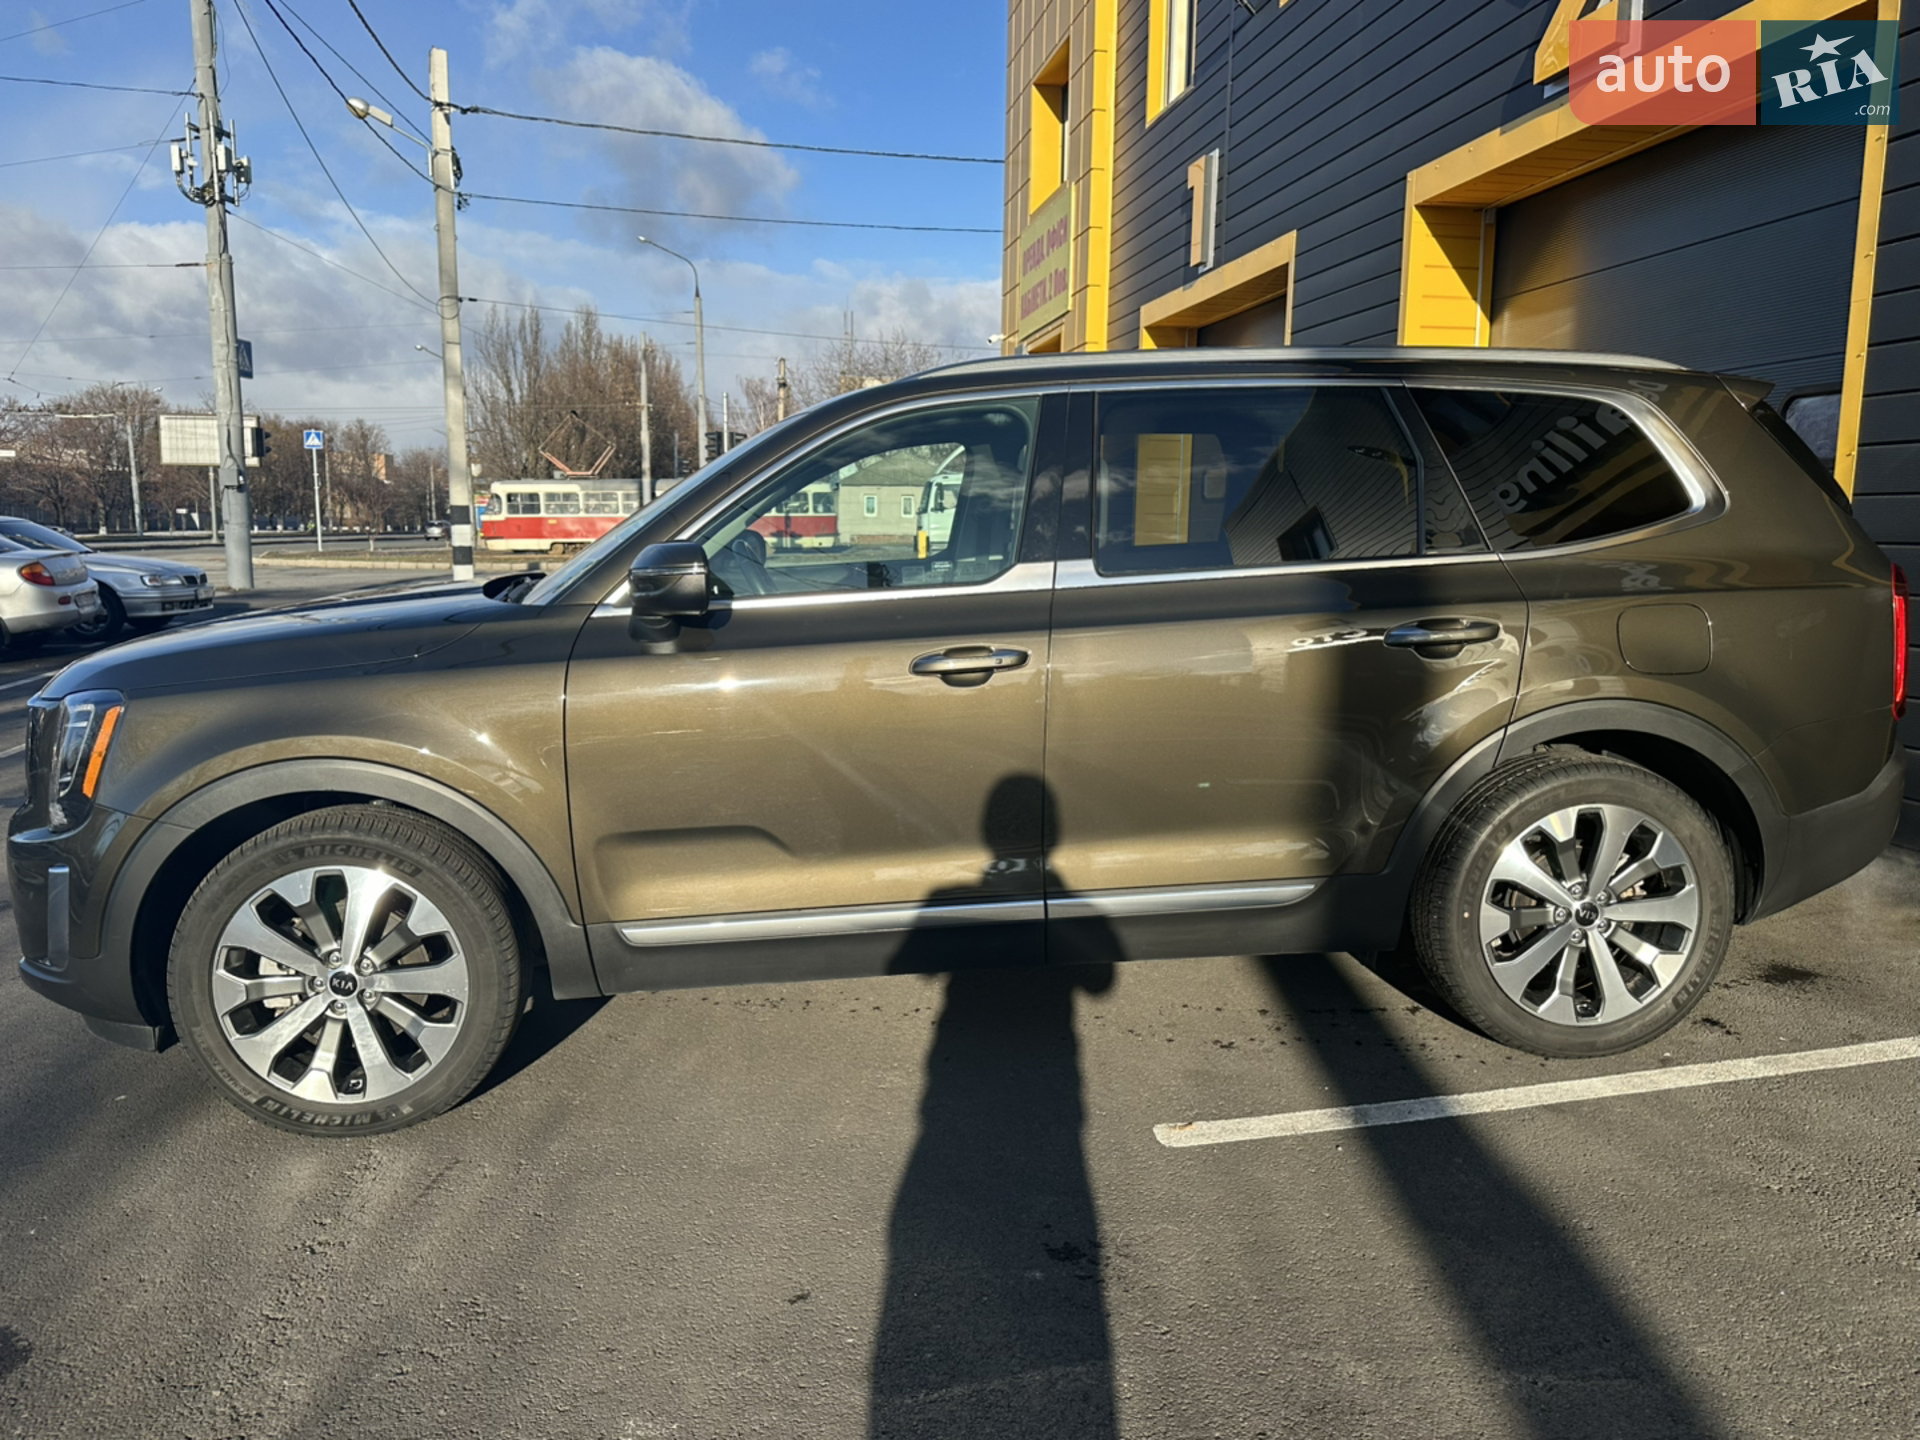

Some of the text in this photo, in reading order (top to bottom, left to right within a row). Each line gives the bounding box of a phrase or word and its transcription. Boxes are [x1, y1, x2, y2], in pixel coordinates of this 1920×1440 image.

[301, 843, 419, 876] MICHELIN
[331, 977, 353, 991] KIA
[260, 1096, 373, 1128] MICHELIN
